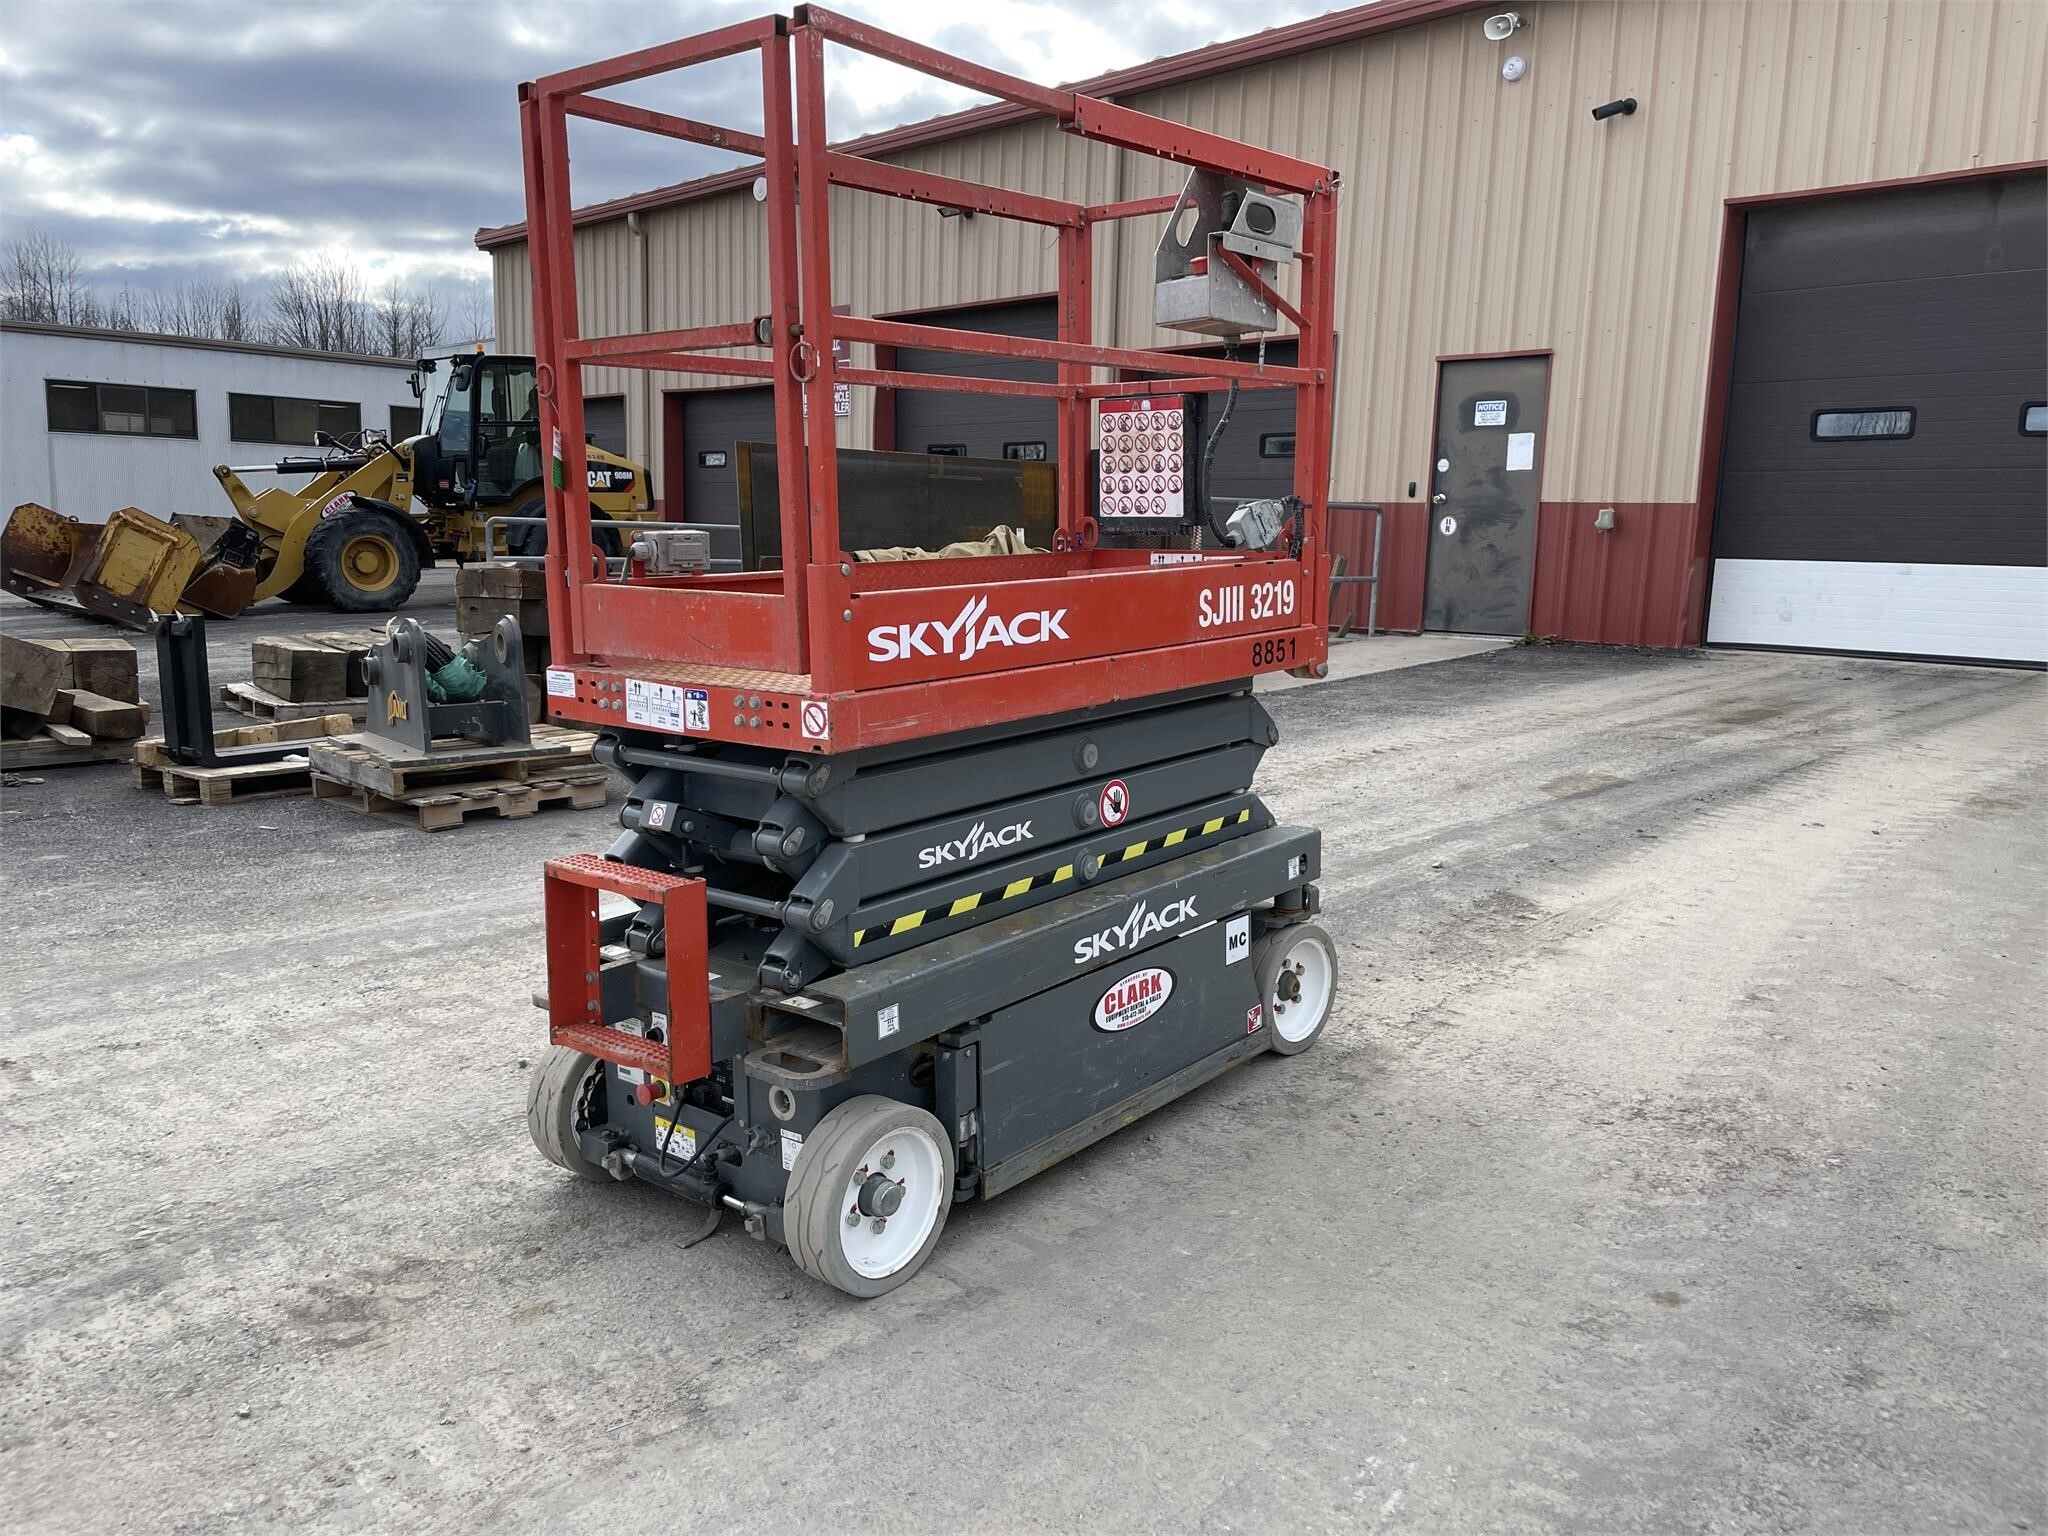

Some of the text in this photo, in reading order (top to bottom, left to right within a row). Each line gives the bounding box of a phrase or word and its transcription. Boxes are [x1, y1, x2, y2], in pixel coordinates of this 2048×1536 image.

[1478, 403, 1505, 411] NOTICE
[587, 470, 633, 488] CAT 908M
[325, 493, 350, 514] CLARK
[1198, 579, 1295, 628] SJIII 3219
[868, 594, 1070, 662] SKYJACK
[1252, 636, 1297, 668] 8851
[918, 820, 1034, 870] SKYJACK
[1073, 895, 1199, 965] SKYJACK
[1228, 931, 1247, 951] MC
[1104, 972, 1162, 1015] CLARK
[1106, 1007, 1130, 1023] EQUIPMENT
[1130, 1001, 1145, 1012] RENTAL
[1149, 993, 1162, 1004] SALES
